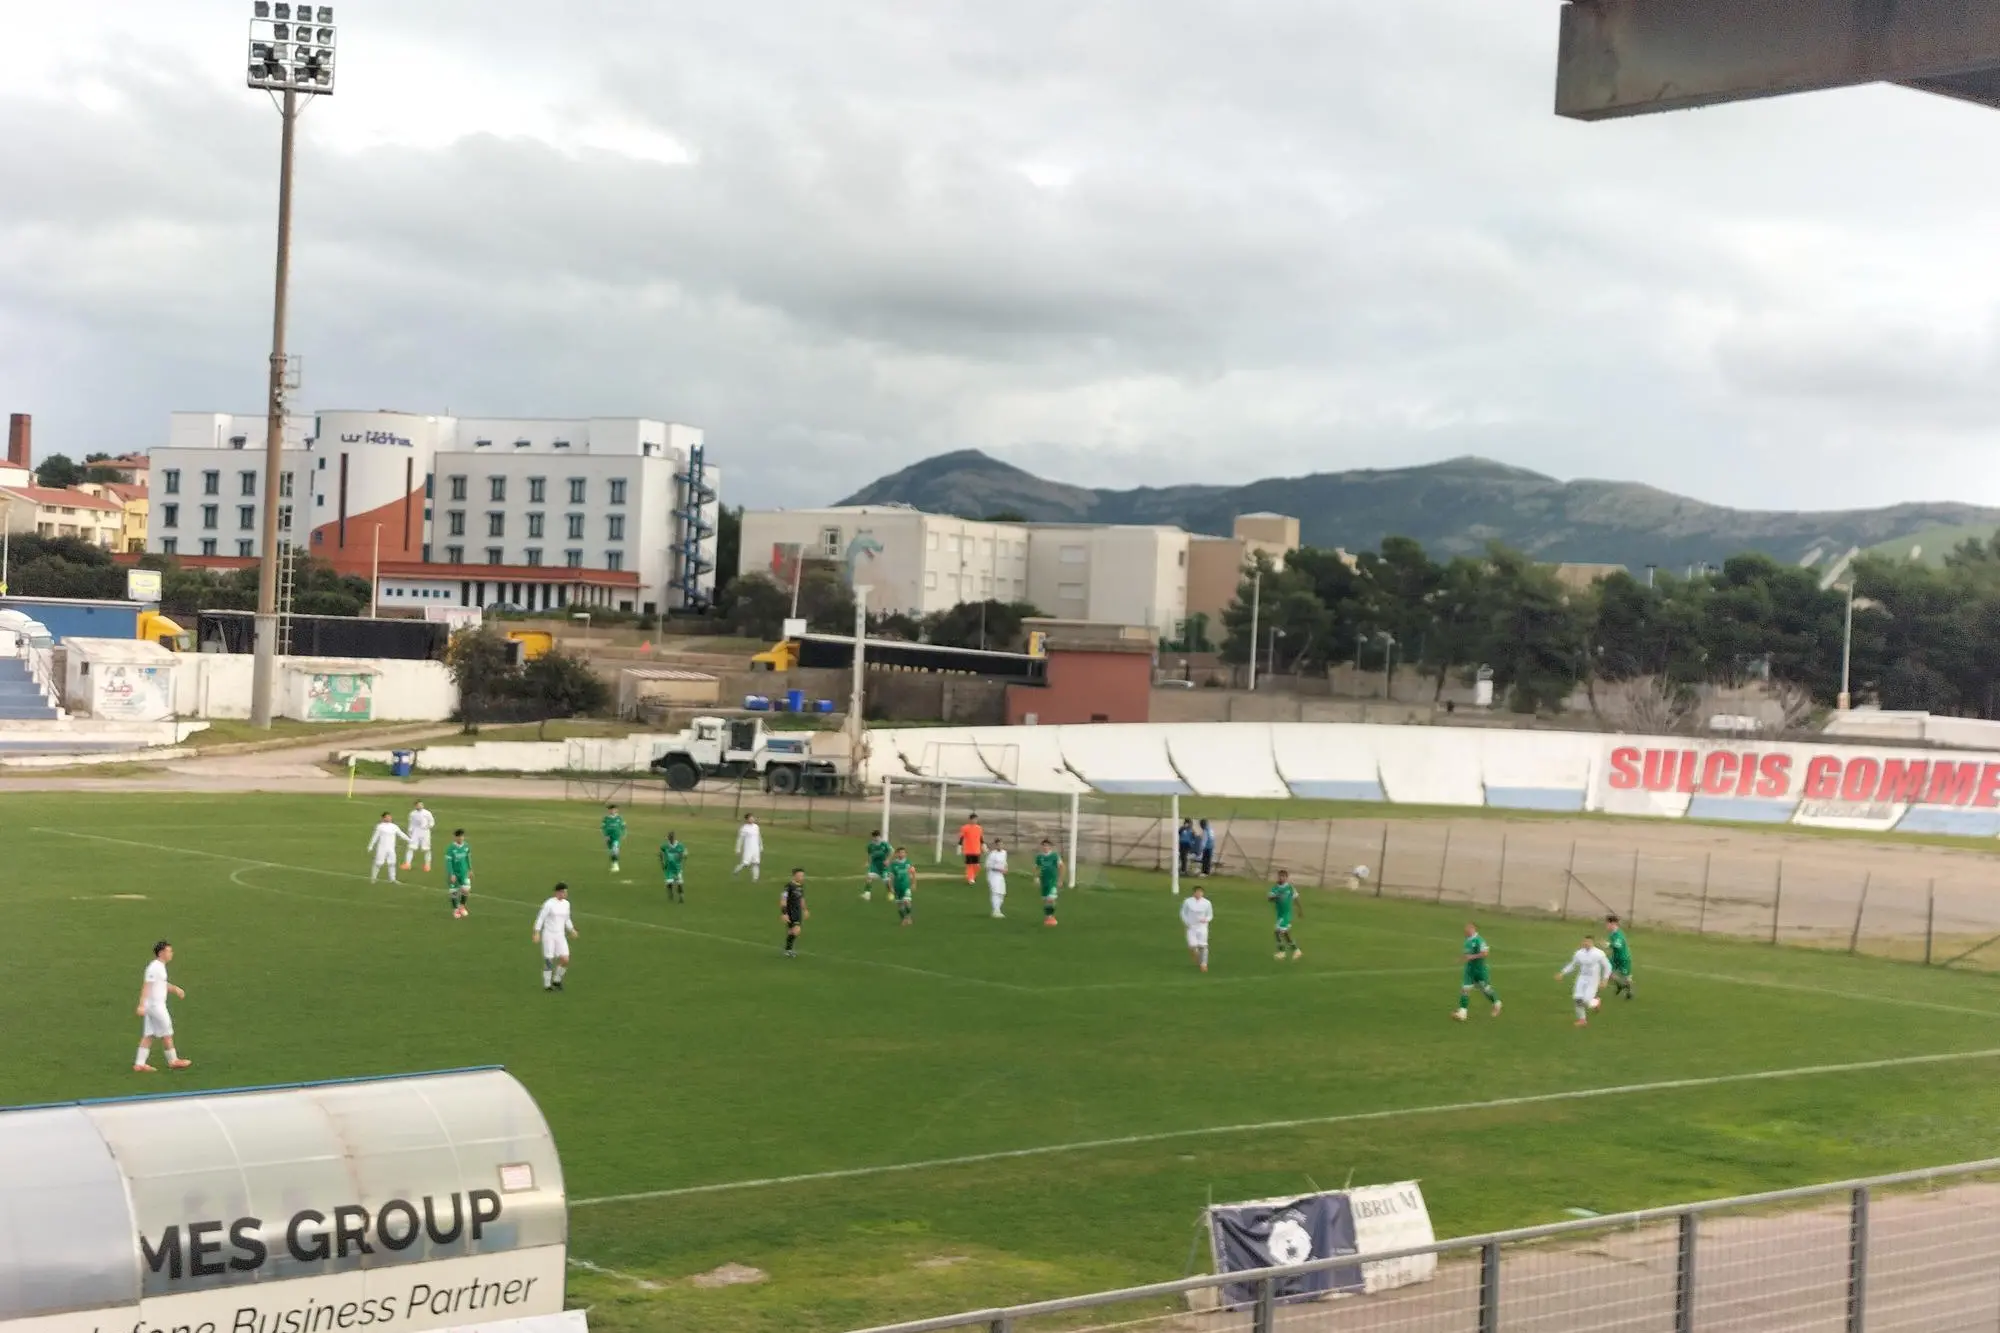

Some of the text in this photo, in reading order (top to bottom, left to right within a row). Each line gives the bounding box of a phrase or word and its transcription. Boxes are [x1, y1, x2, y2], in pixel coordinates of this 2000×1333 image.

[1608, 746, 2000, 807] SULCIS GOMME
[286, 1188, 503, 1262] GROUP
[232, 1277, 538, 1333] Business Partner
